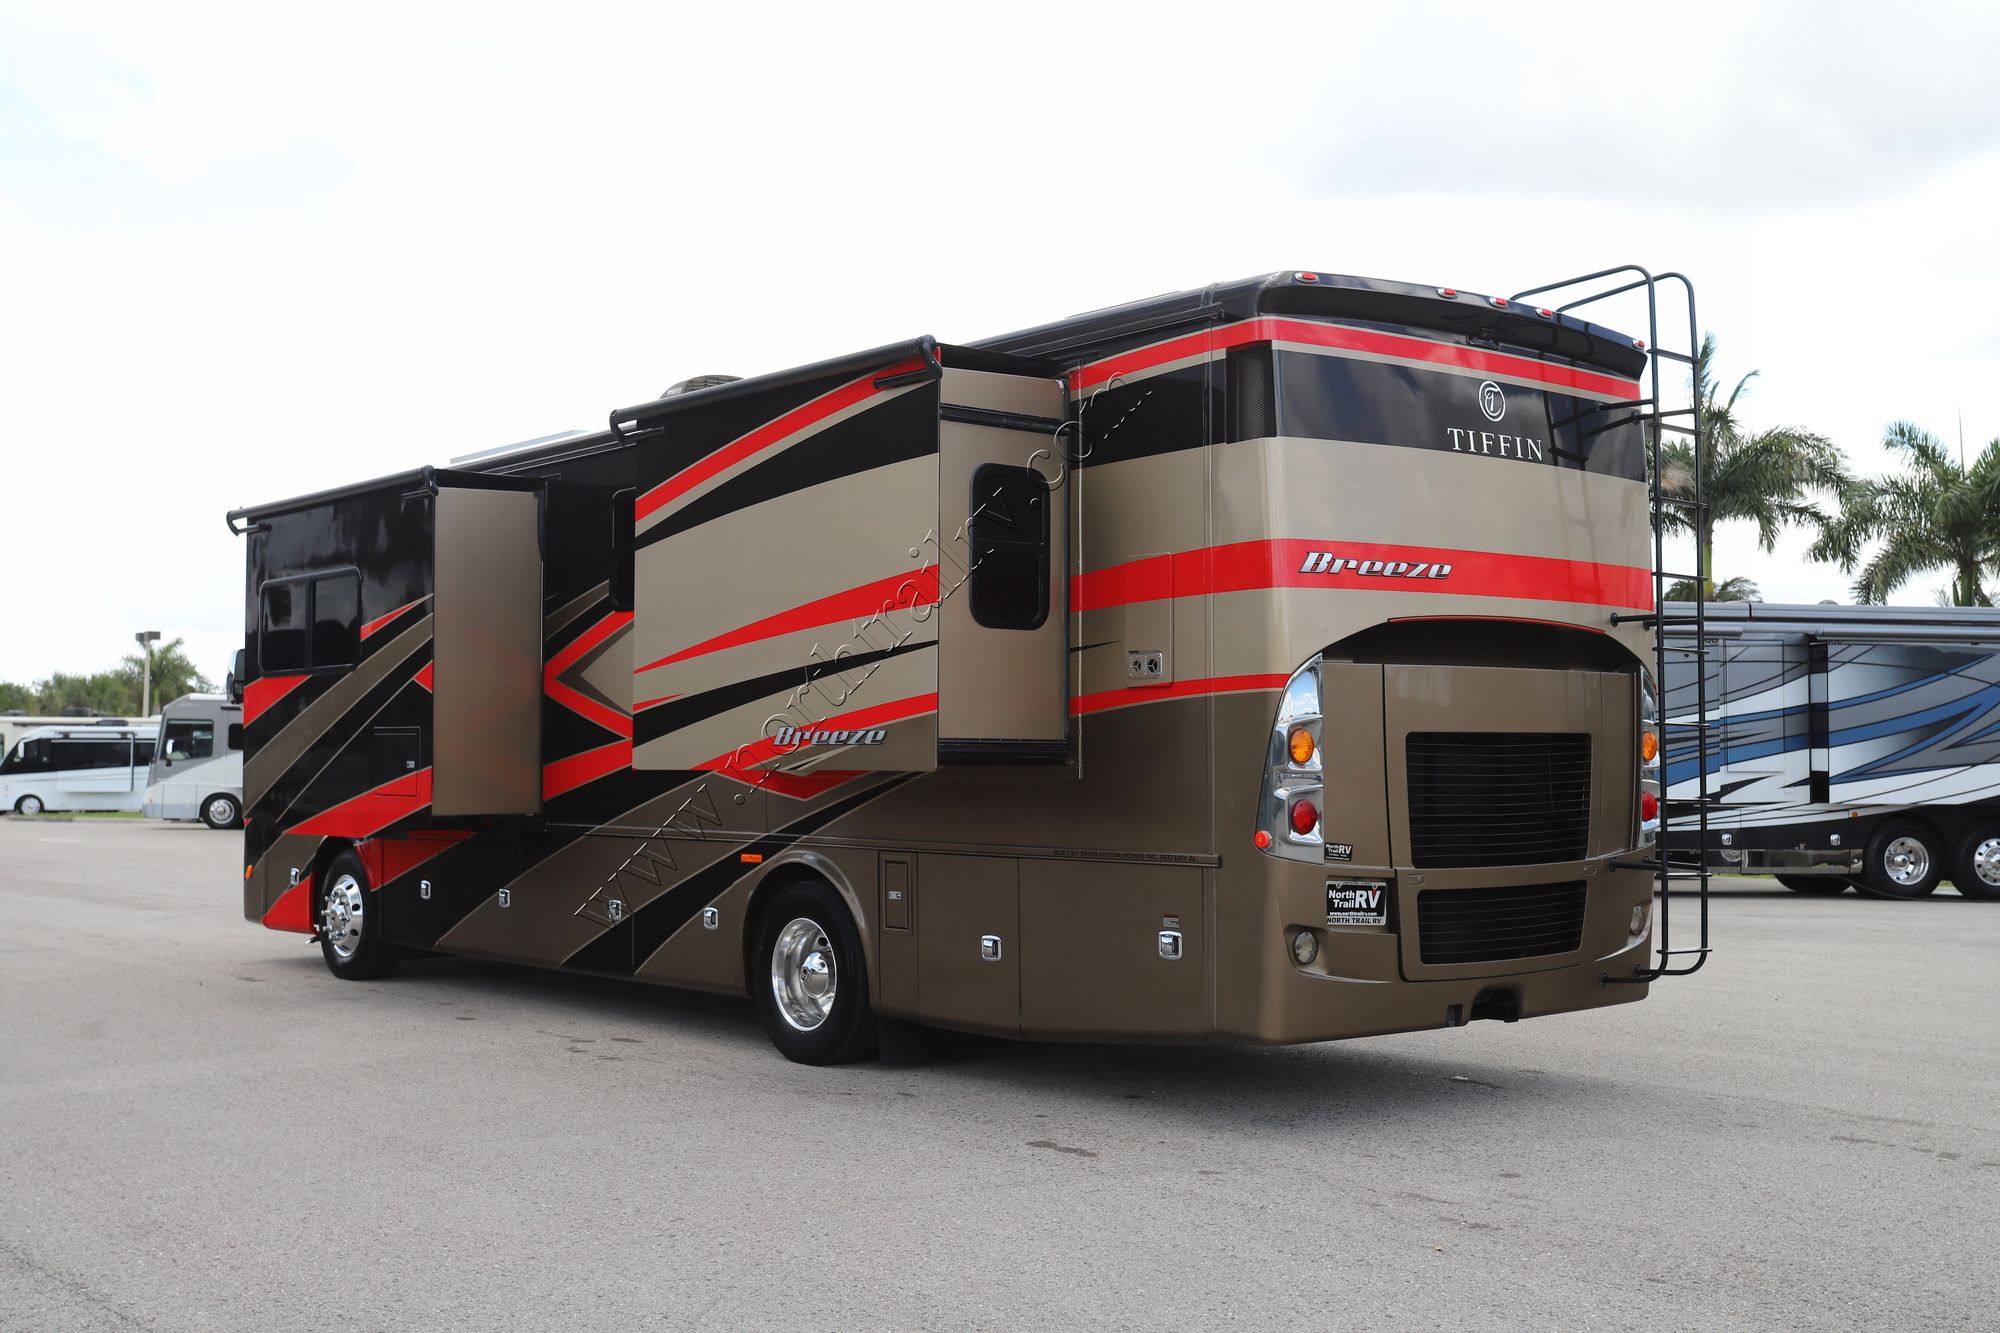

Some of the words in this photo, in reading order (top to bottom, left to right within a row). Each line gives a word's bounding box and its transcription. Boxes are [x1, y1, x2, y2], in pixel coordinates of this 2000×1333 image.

[1447, 427, 1542, 461] TIFFIN
[1299, 551, 1452, 580] Breeze
[773, 726, 887, 746] Breeze
[1339, 845, 1352, 854] RV
[1328, 890, 1355, 899] North
[1333, 899, 1355, 908] Trail
[1355, 890, 1381, 909] RV
